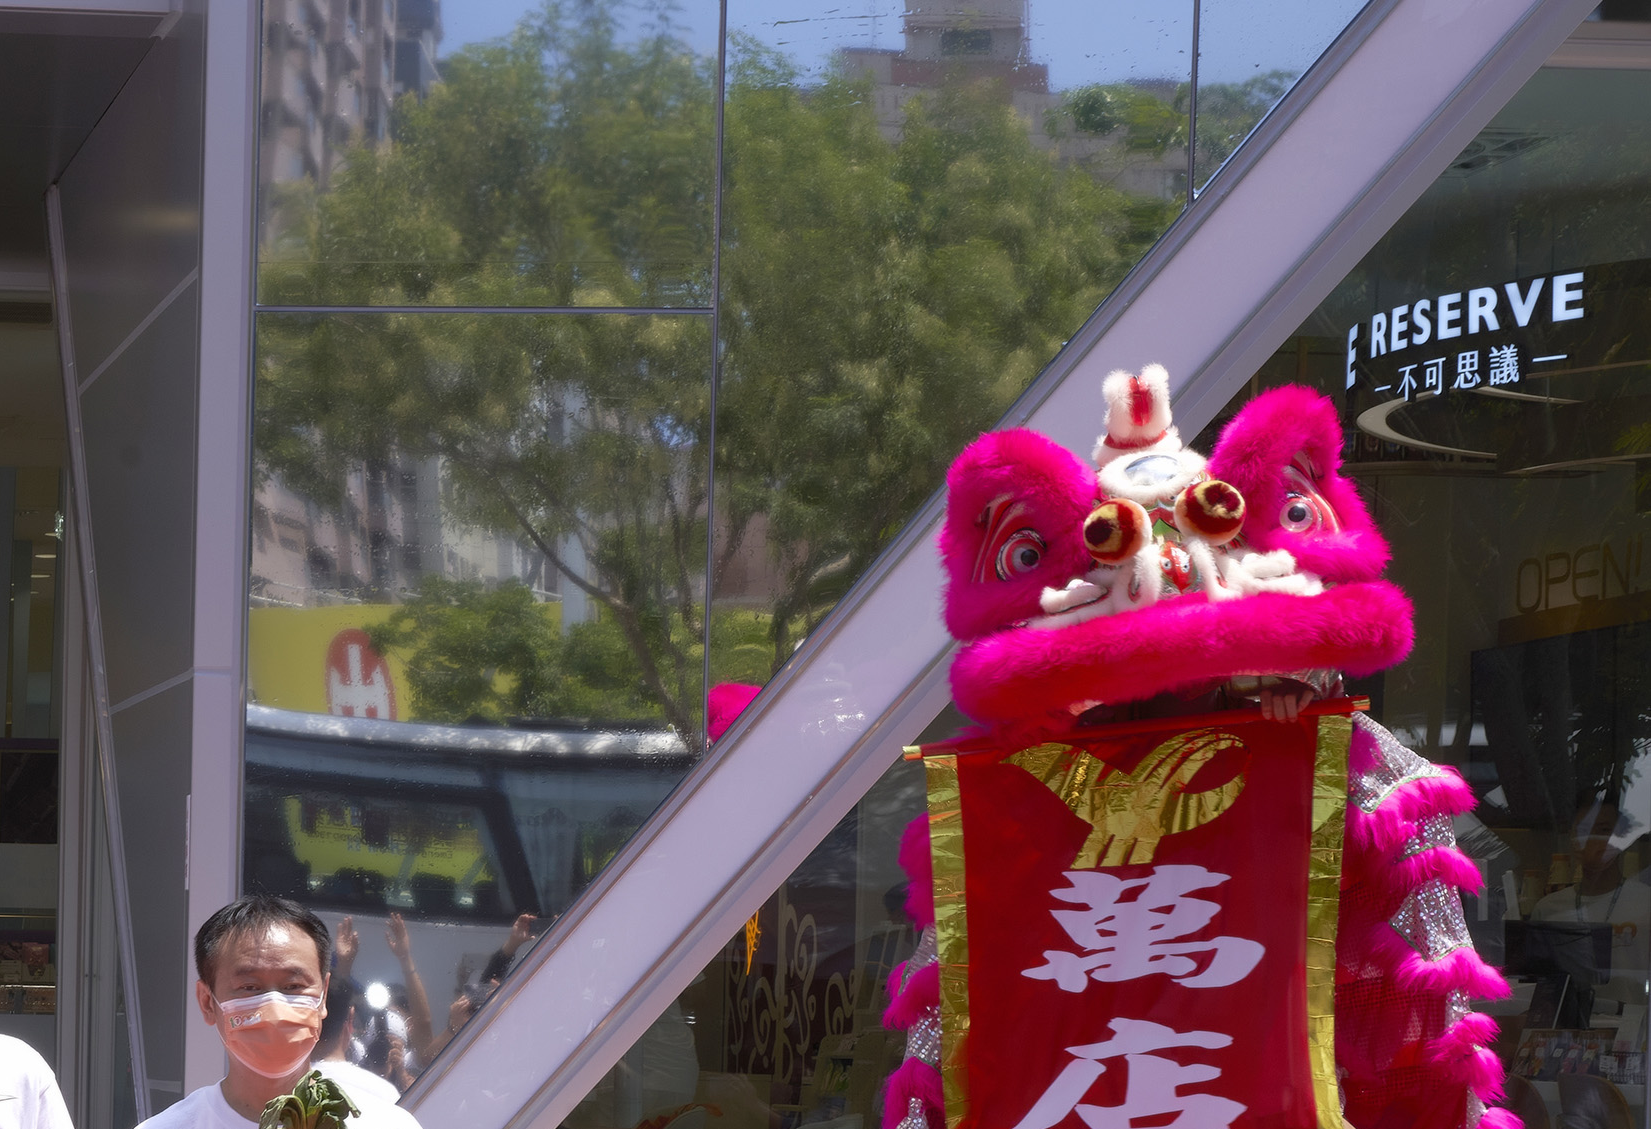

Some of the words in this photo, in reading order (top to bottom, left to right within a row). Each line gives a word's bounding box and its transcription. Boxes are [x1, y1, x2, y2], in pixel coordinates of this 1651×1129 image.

[1370, 271, 1585, 360] RESERVE
[1396, 344, 1521, 402] 不可思議
